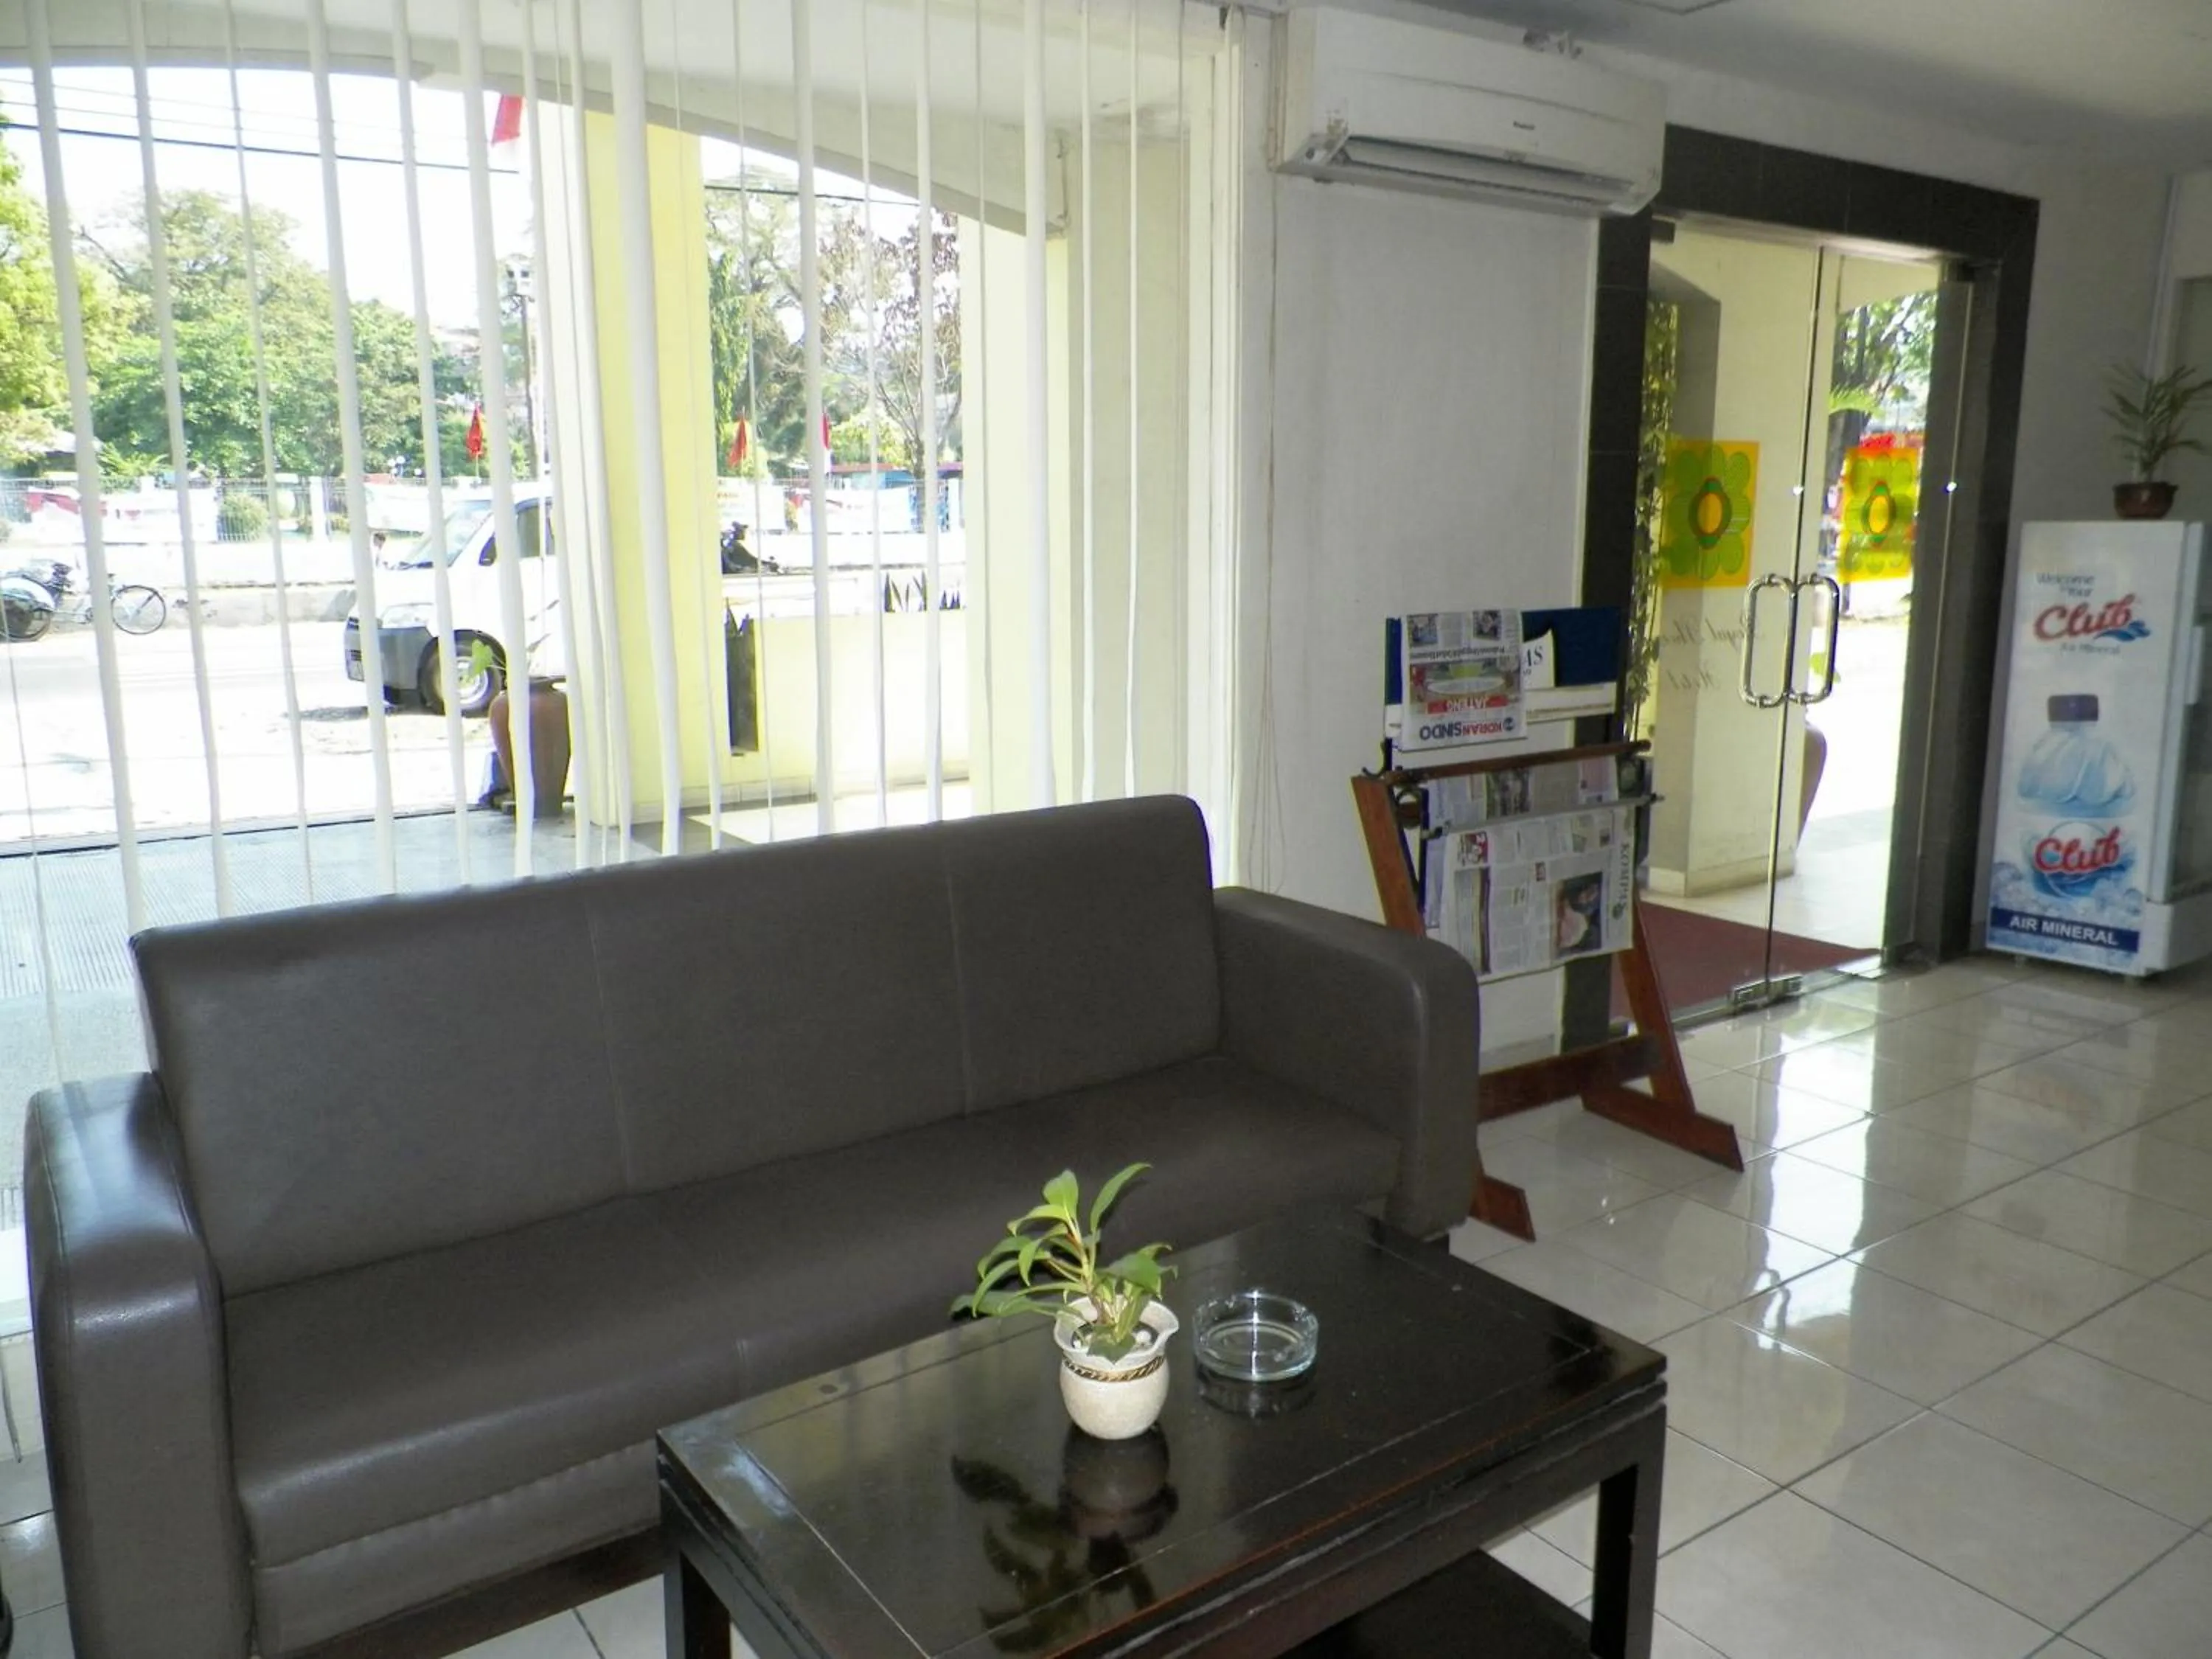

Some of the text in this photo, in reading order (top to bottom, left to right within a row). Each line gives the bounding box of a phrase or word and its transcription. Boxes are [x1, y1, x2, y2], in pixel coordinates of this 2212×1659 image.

[2033, 593, 2138, 642] Club
[2033, 827, 2121, 874] Club
[2009, 914, 2118, 946] AIR MINERAL
